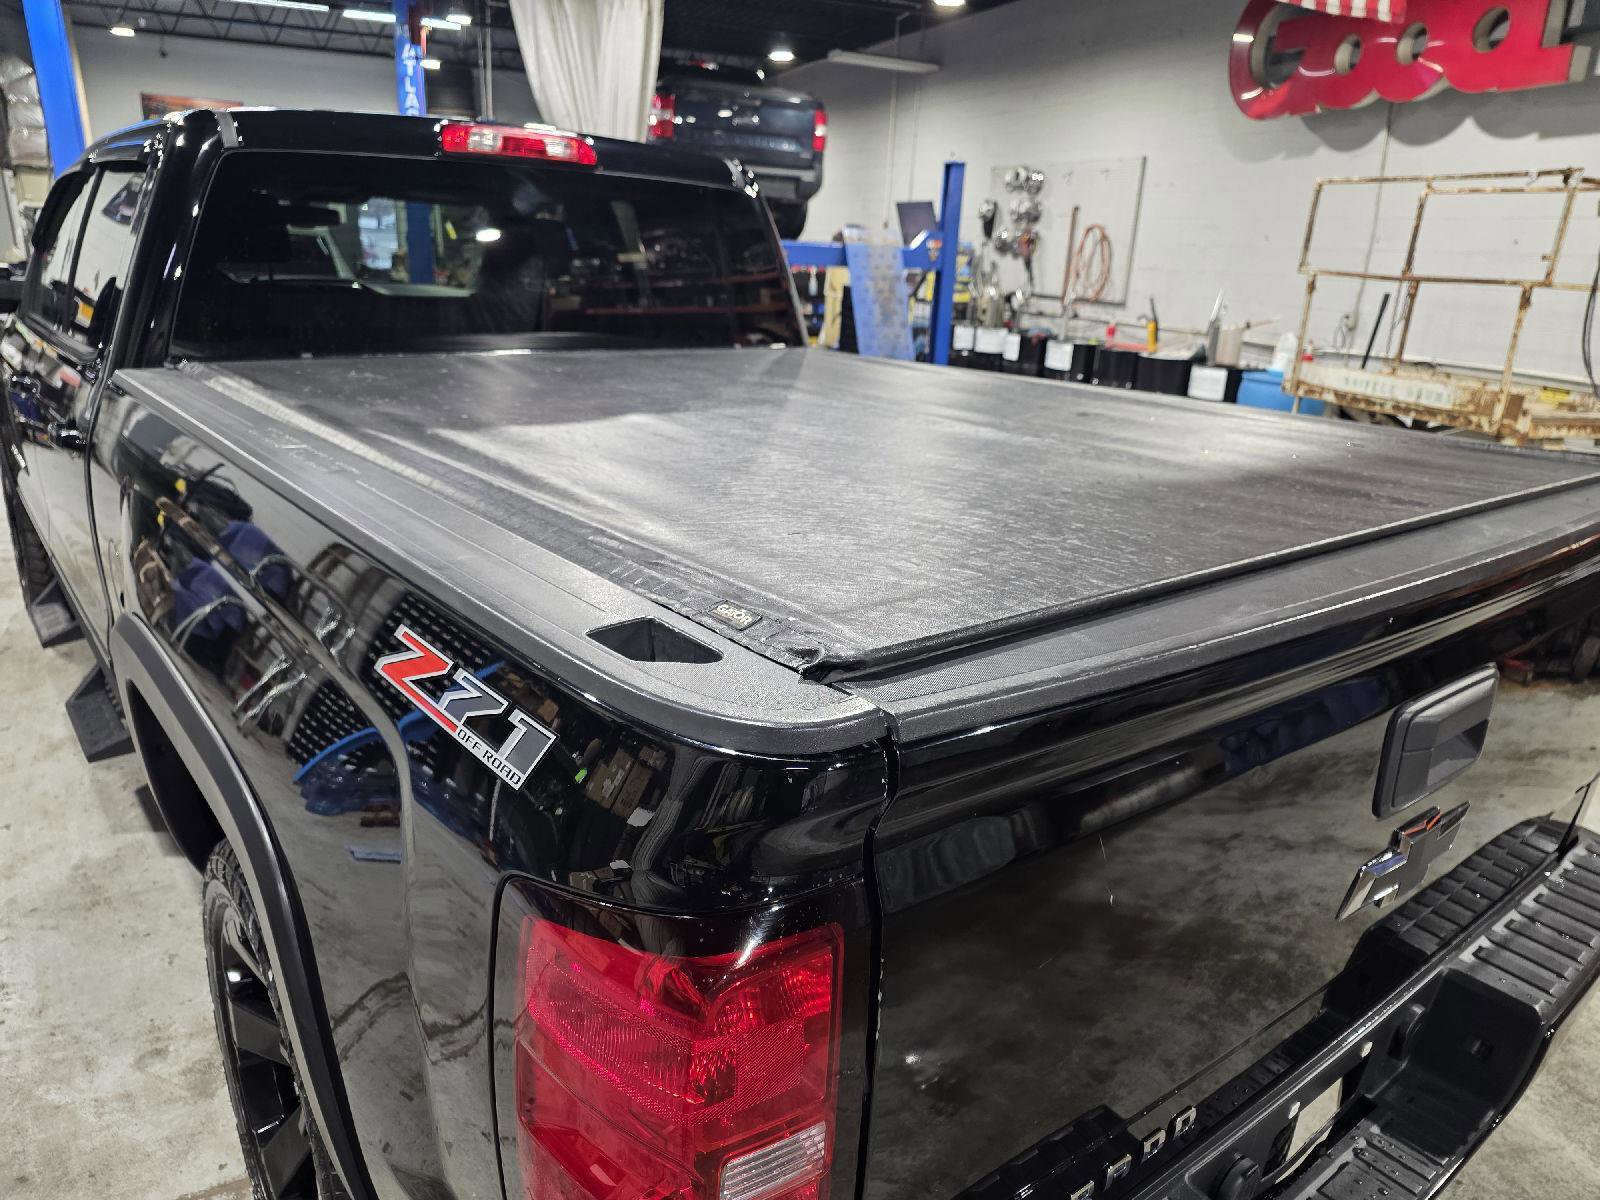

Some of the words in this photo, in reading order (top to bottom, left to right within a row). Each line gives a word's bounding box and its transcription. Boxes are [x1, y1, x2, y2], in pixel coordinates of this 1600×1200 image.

[374, 624, 557, 777] Z71
[457, 729, 483, 753] OFF
[482, 752, 522, 786] ROAD
